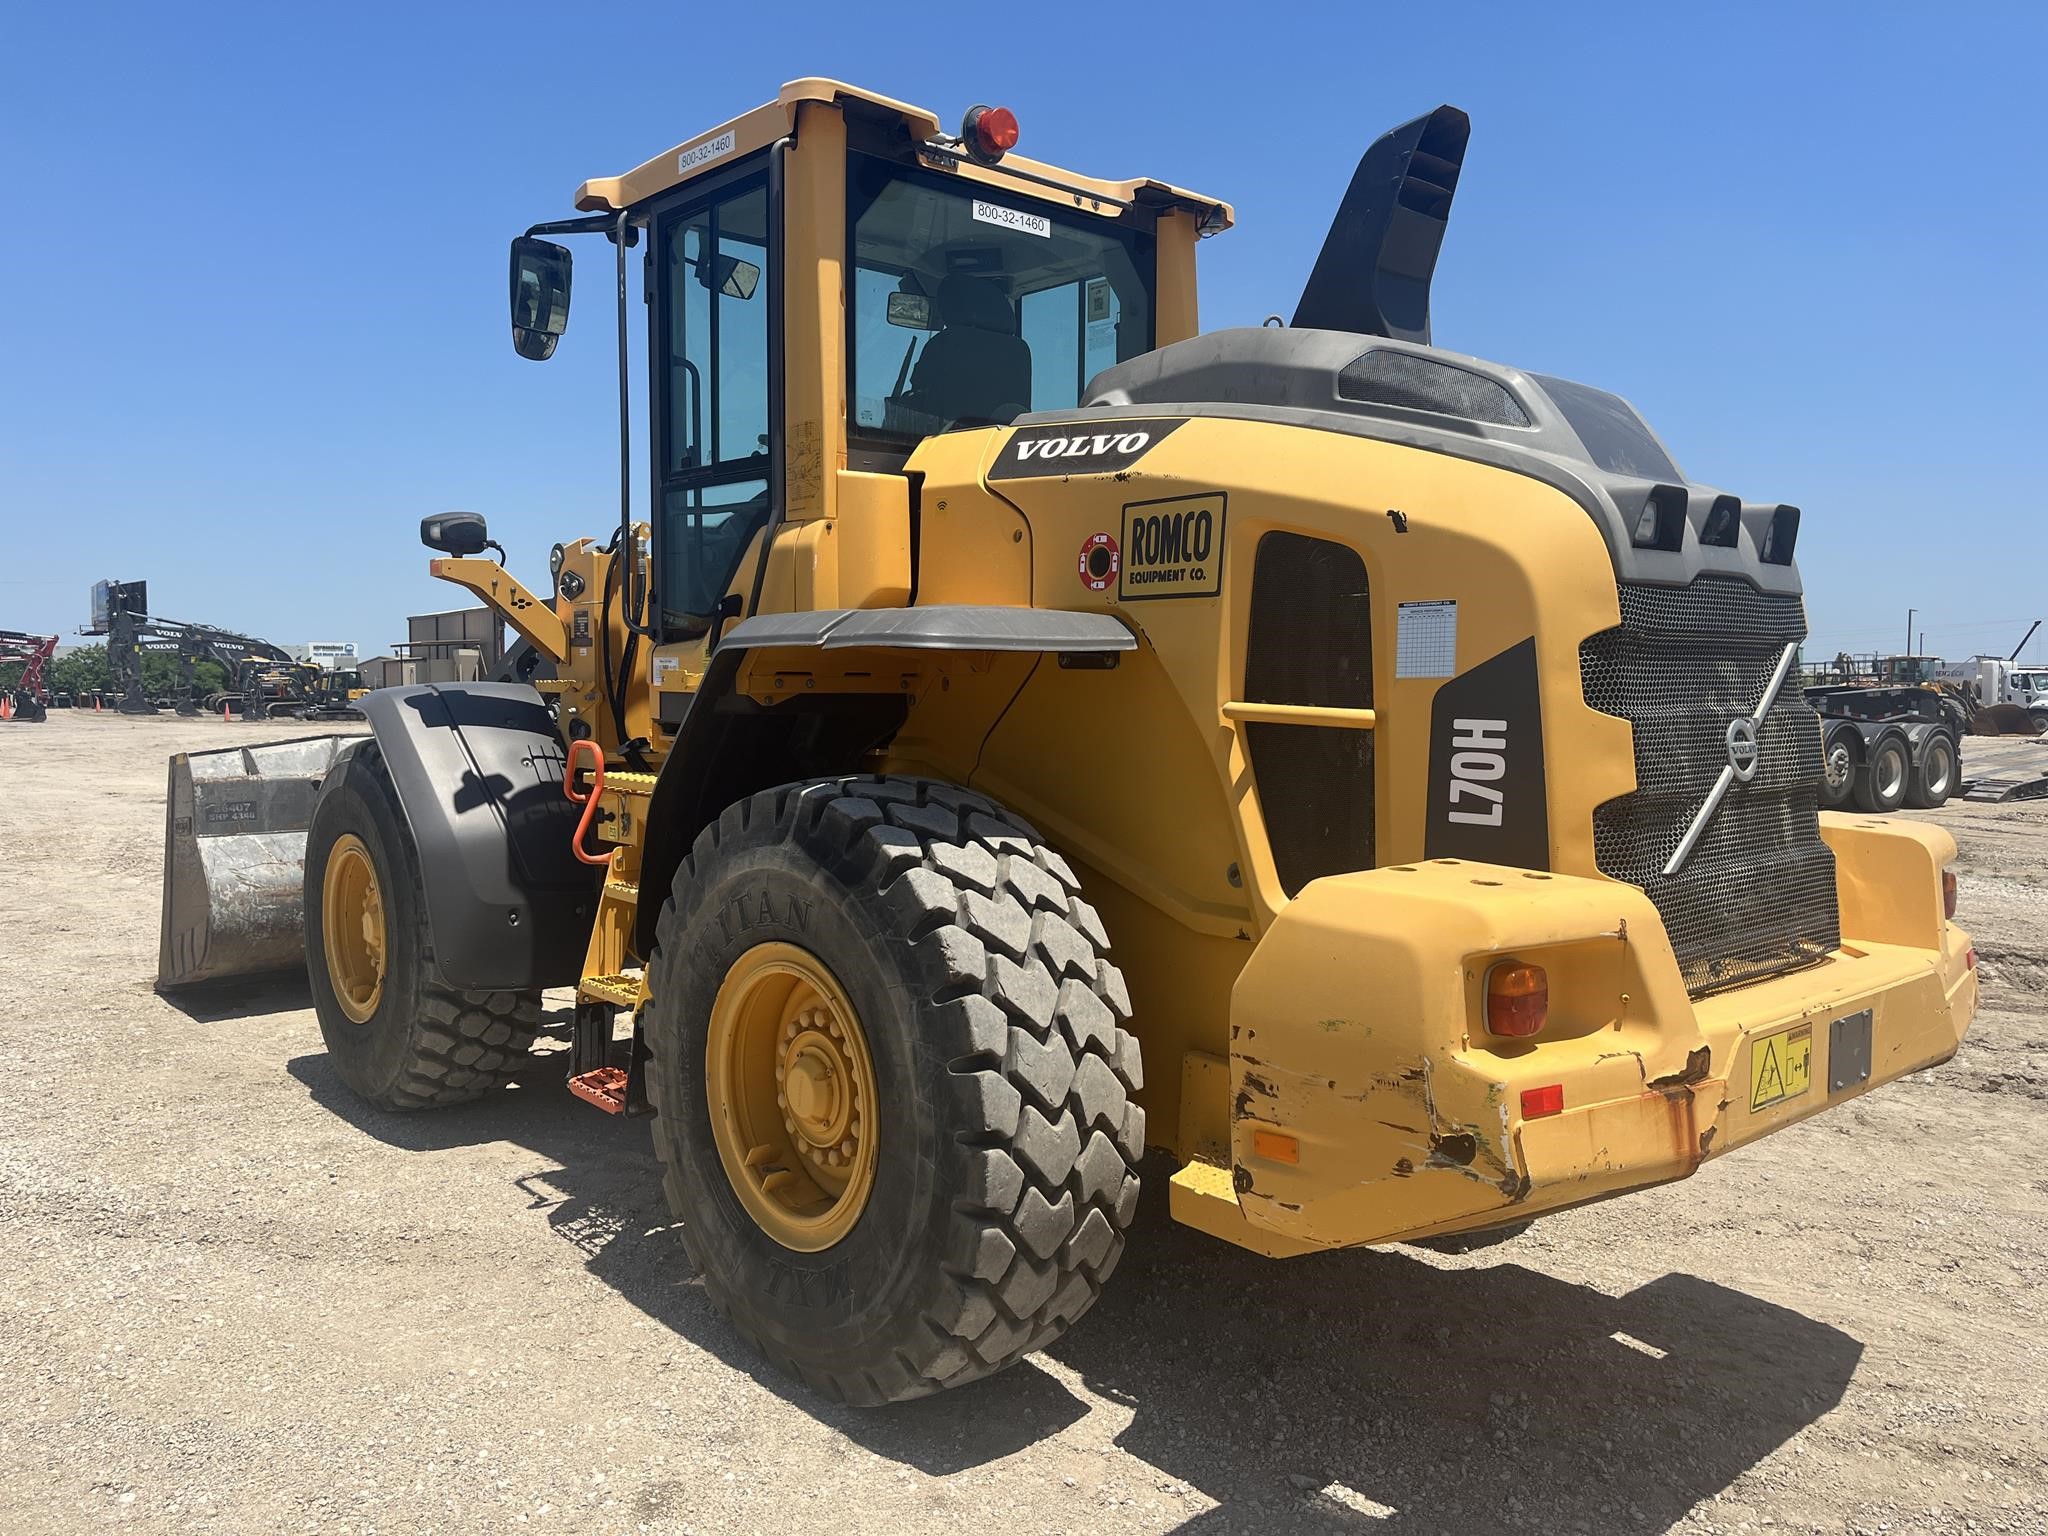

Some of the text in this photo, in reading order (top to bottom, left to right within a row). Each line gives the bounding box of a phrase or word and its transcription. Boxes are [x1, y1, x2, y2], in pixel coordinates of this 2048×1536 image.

[681, 135, 731, 168] 800-32-1460
[977, 203, 1045, 232] 800-32-1460
[1016, 432, 1150, 461] VOLVO
[1130, 510, 1213, 567] ROMCO
[1129, 567, 1207, 585] EQUIPMENT CO.
[155, 629, 182, 638] VOLV
[212, 641, 245, 651] VOLVO
[1448, 718, 1508, 827] L70H
[695, 887, 816, 971] TITAN
